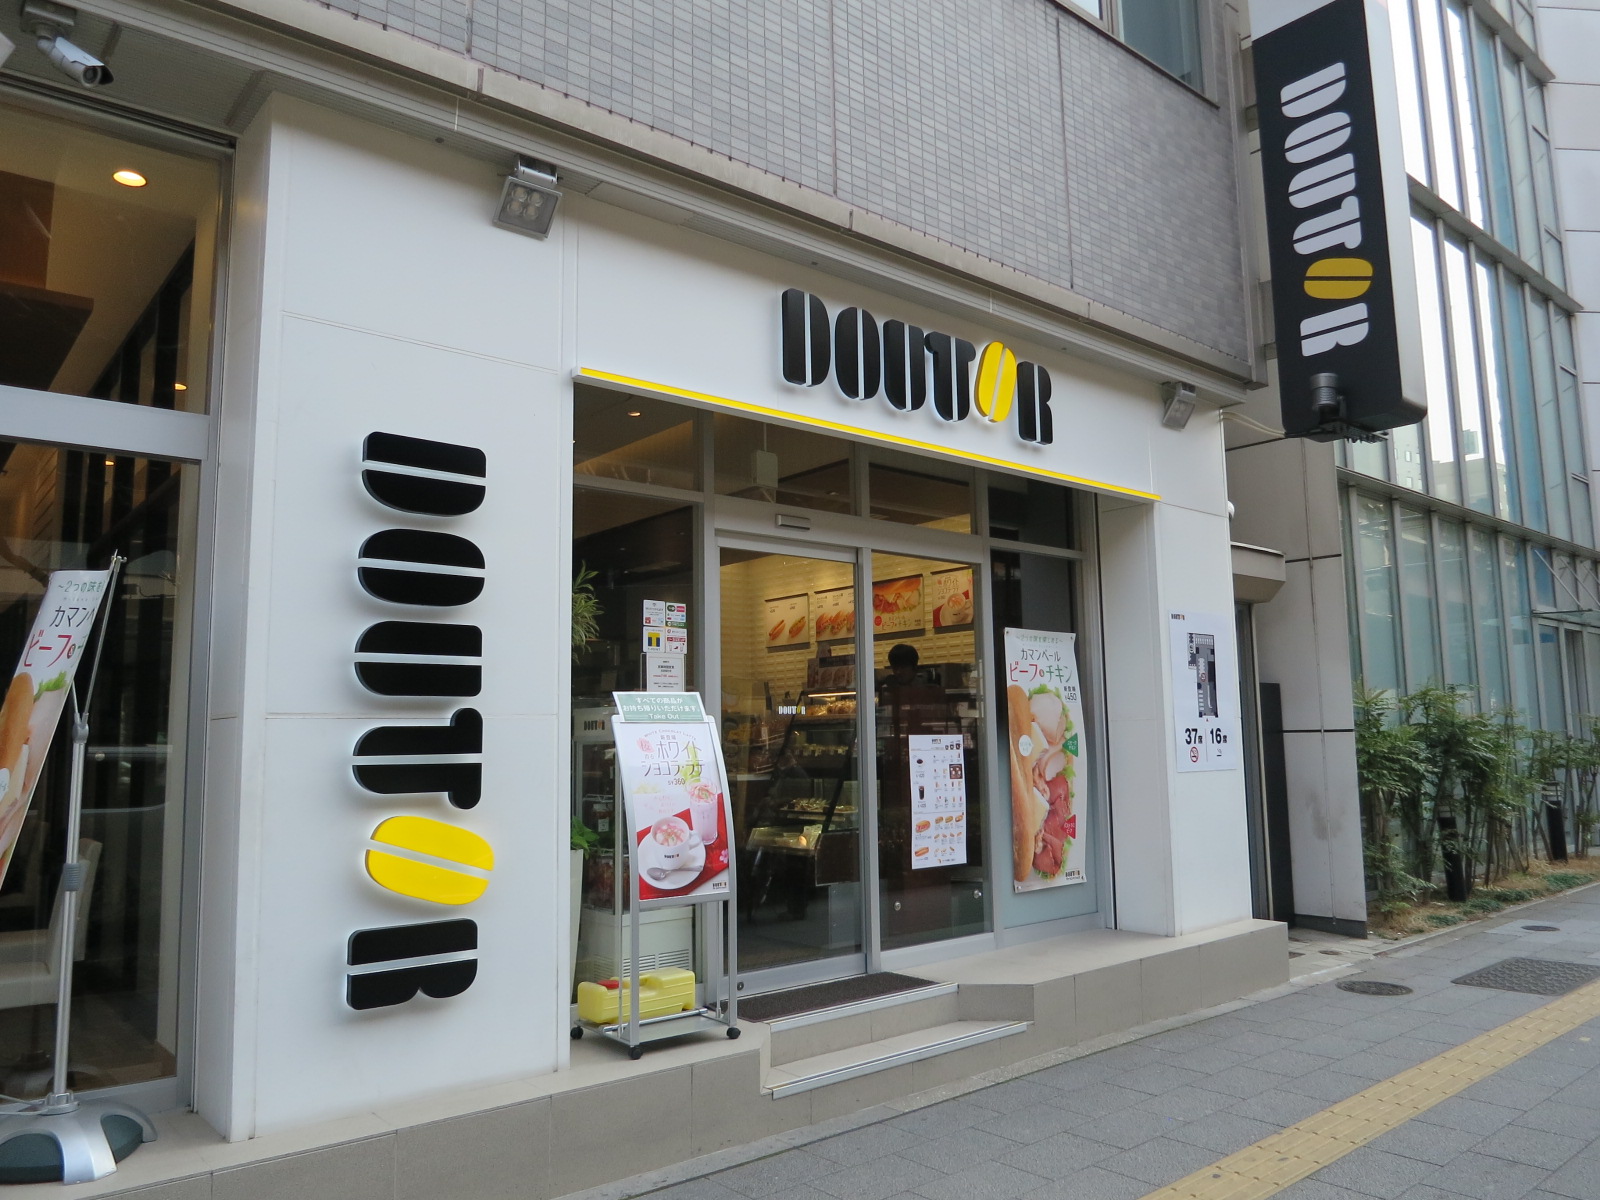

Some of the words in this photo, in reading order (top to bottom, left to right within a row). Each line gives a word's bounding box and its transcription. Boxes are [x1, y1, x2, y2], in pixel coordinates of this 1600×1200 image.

[1280, 62, 1374, 357] DOUTOR
[781, 287, 1054, 446] DOUTOR
[1020, 647, 1062, 662] カマンベール
[346, 431, 494, 1011] DOUTOR
[656, 740, 702, 760] ホワイト
[778, 705, 806, 715] DOUTOR
